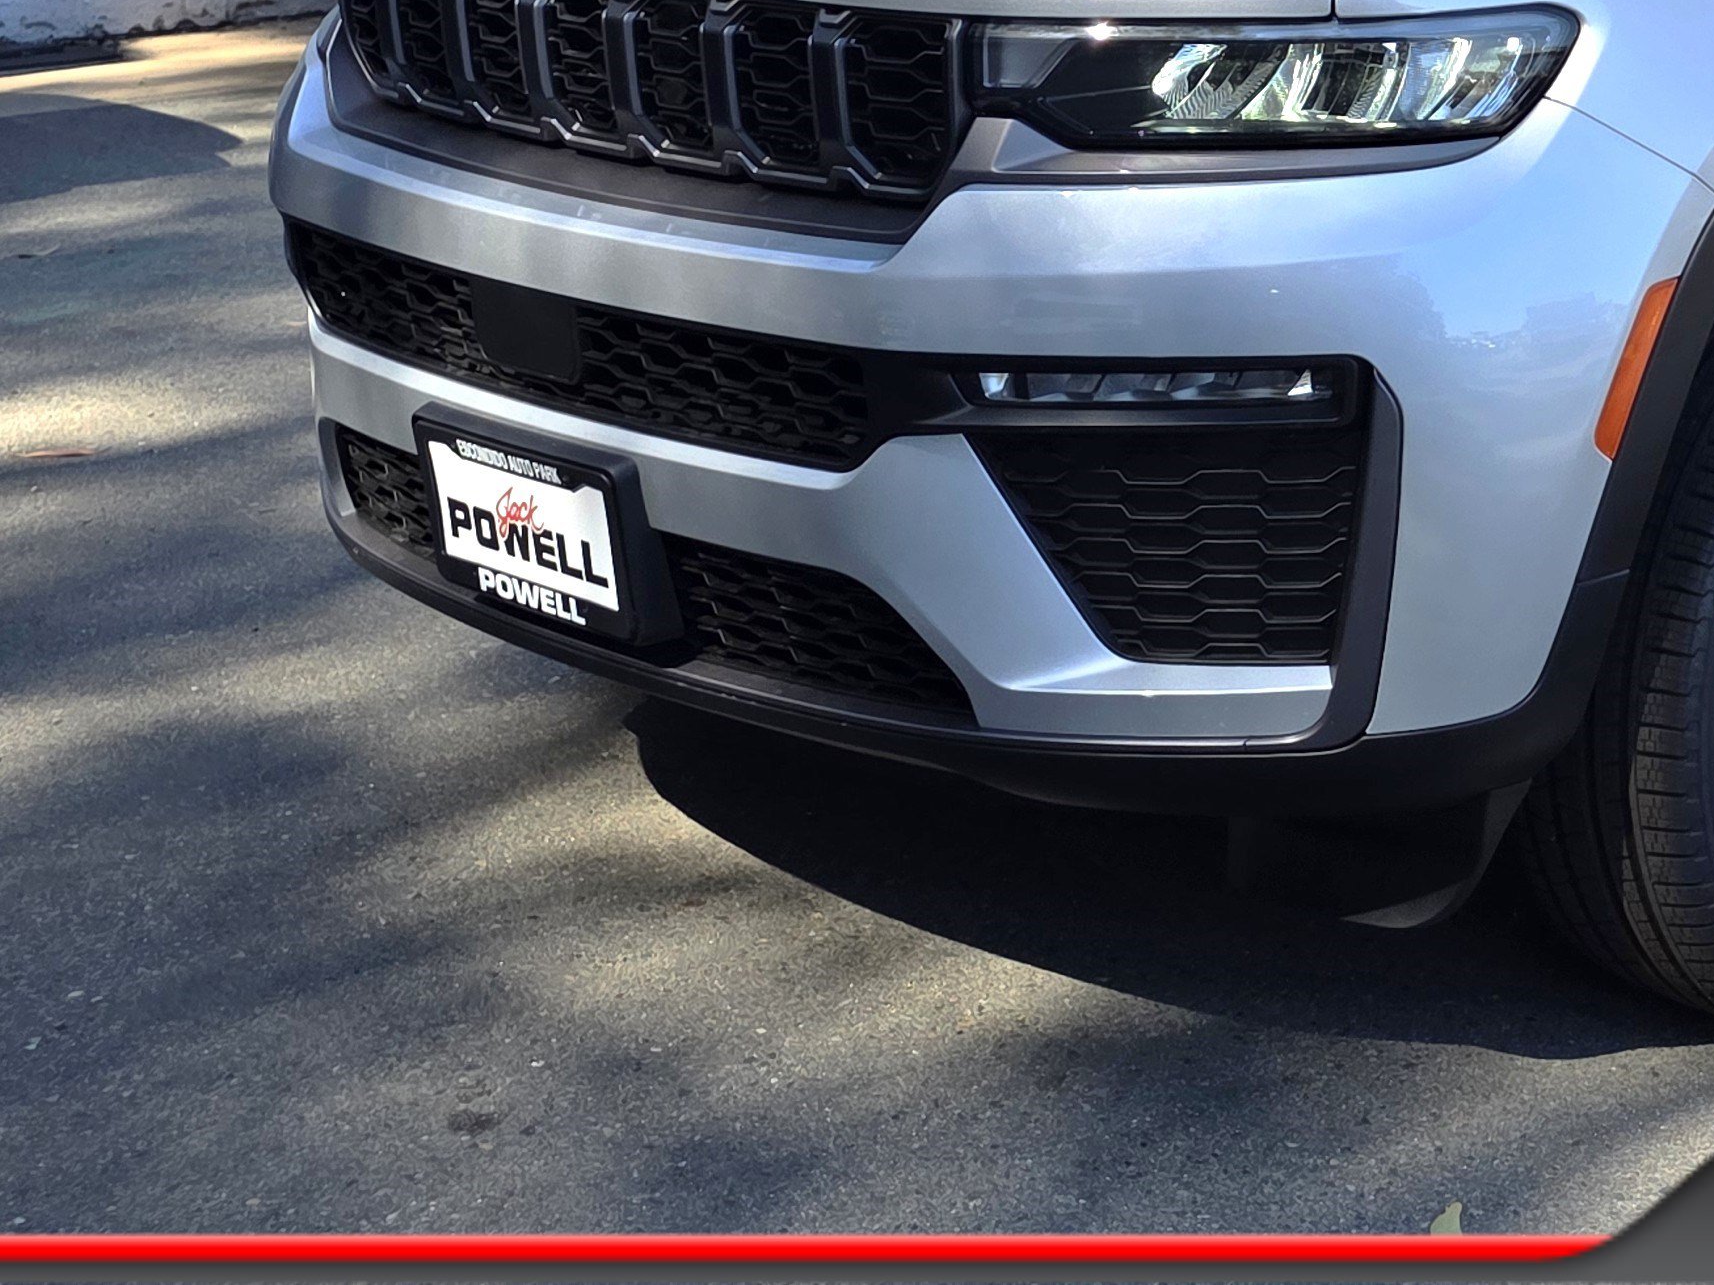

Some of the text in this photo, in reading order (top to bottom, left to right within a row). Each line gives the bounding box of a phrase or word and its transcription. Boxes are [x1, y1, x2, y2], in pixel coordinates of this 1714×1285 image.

[507, 455, 534, 477] AUTO
[532, 461, 562, 485] PARK
[496, 486, 544, 538] Jack
[447, 496, 609, 589] POWELL
[477, 566, 587, 626] POWELL
